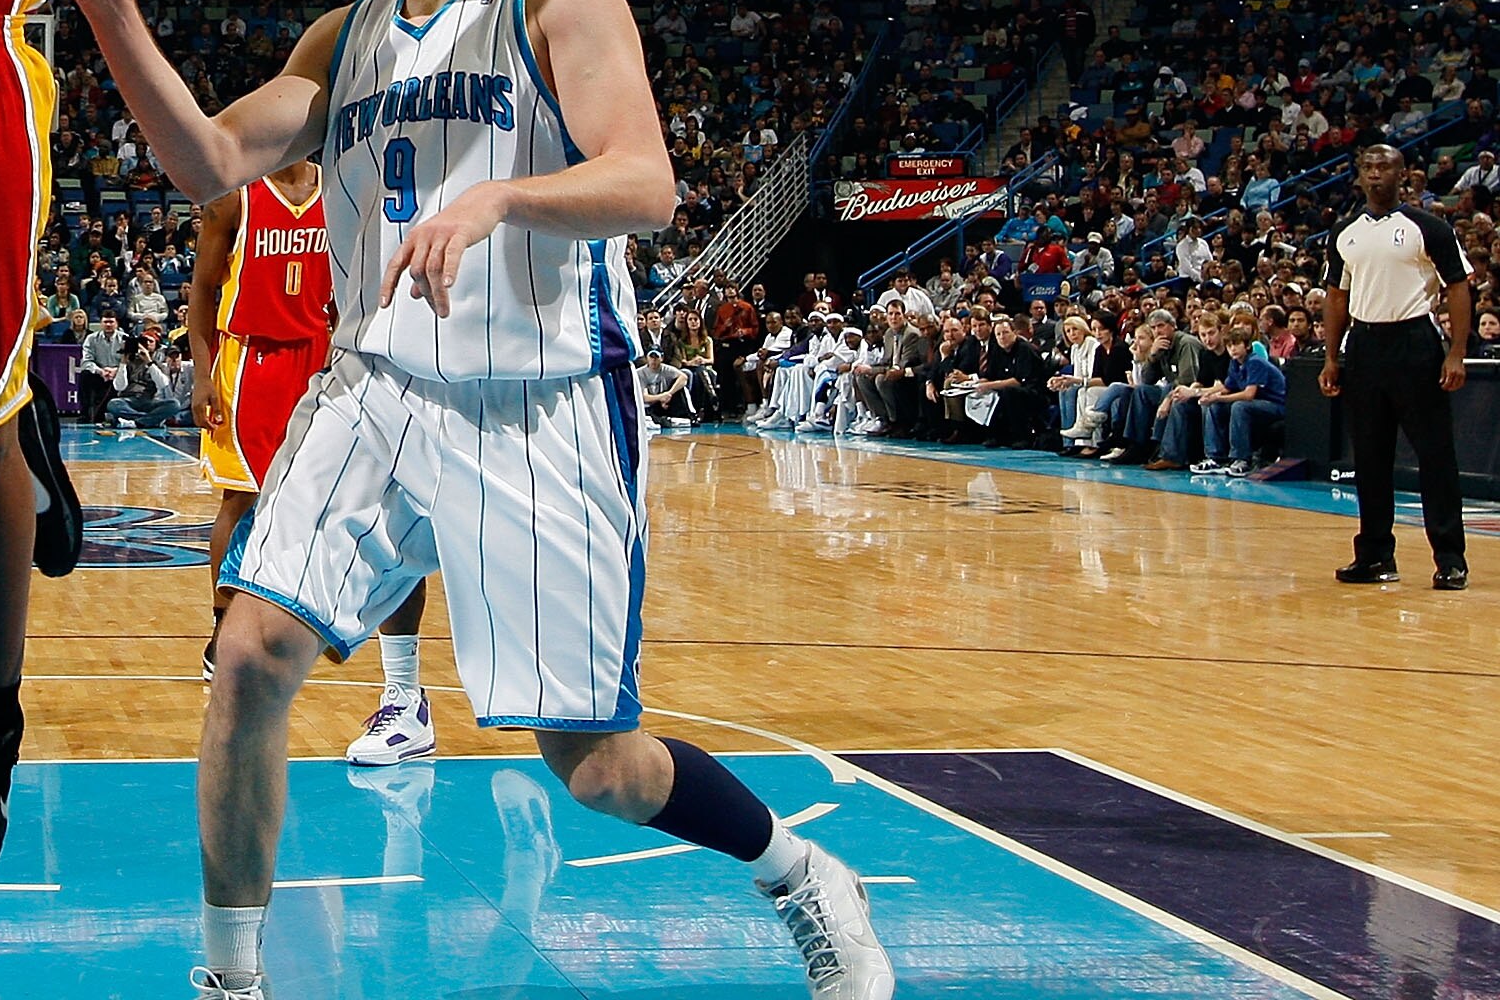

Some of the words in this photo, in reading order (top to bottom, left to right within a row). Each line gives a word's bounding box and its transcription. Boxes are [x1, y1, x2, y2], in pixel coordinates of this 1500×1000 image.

[381, 72, 515, 131] ORLEANS
[383, 137, 419, 223] 9
[899, 159, 953, 168] EMERGENCY
[916, 168, 935, 176] EXIT
[840, 181, 977, 221] Budweiser
[285, 261, 303, 296] 0
